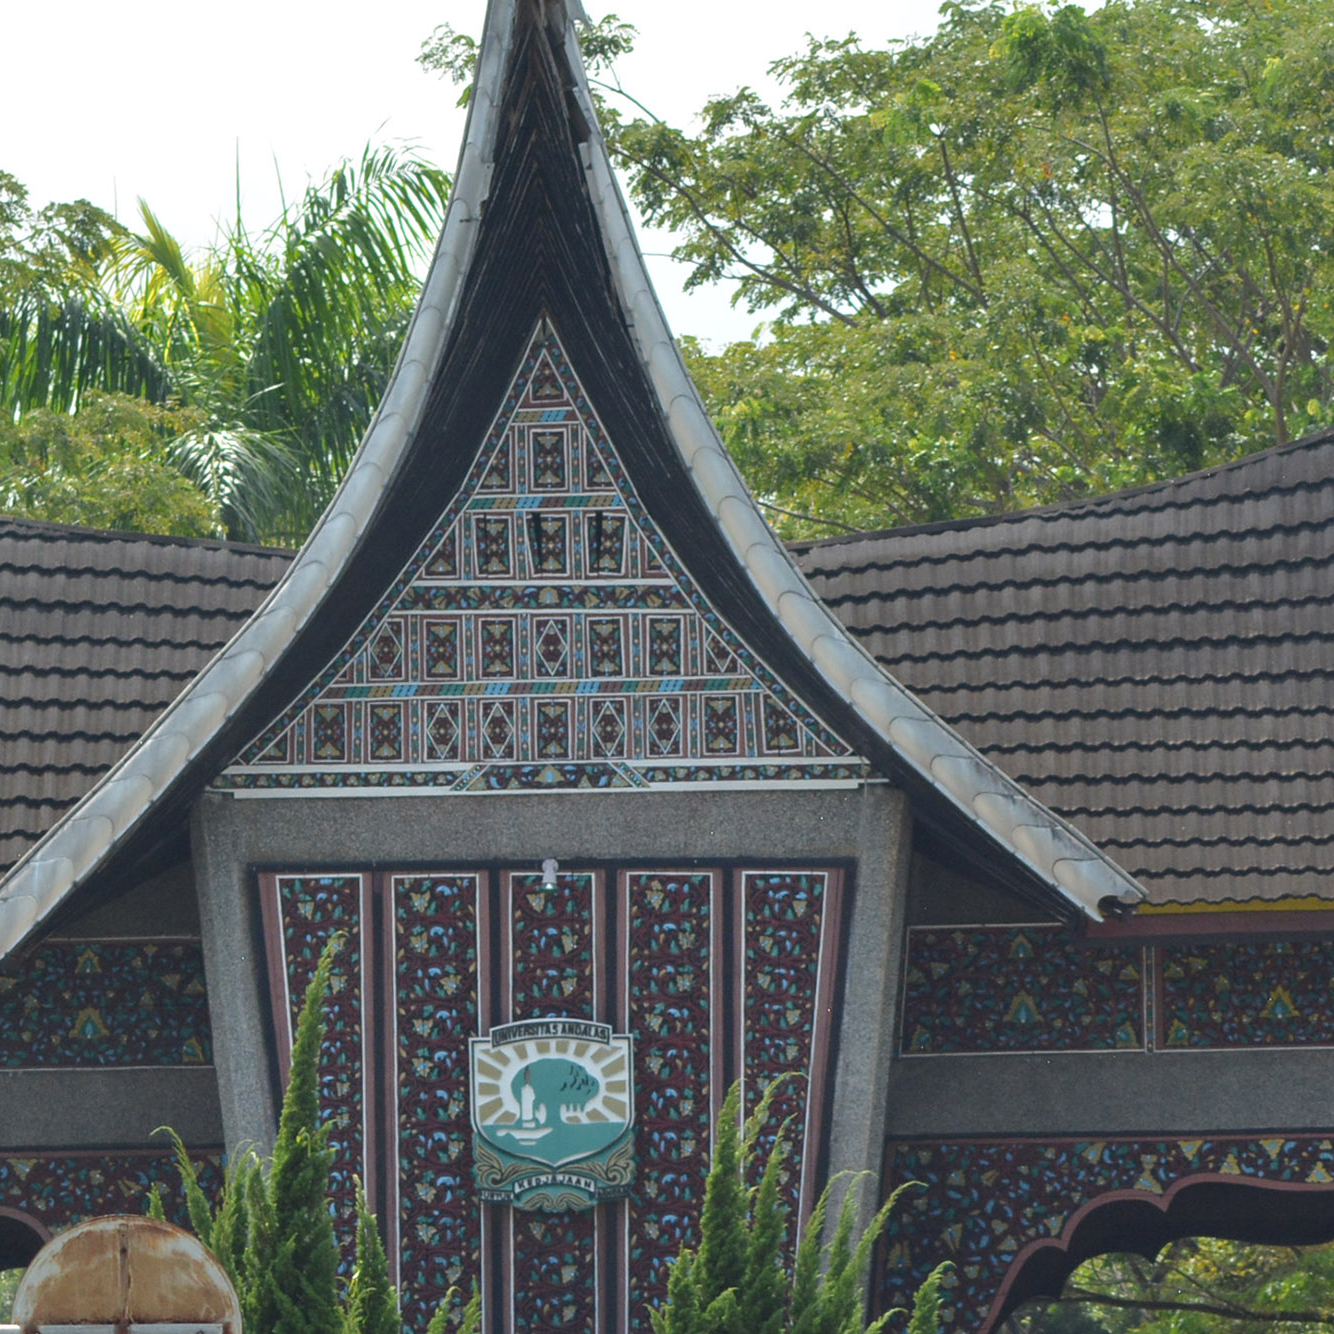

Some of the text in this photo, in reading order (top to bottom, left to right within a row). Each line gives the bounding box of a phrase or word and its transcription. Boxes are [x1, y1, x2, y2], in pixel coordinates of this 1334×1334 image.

[494, 1023, 607, 1043] UNIVERSITAS ANDALAS
[518, 1174, 592, 1190] KEDJAJAAN
